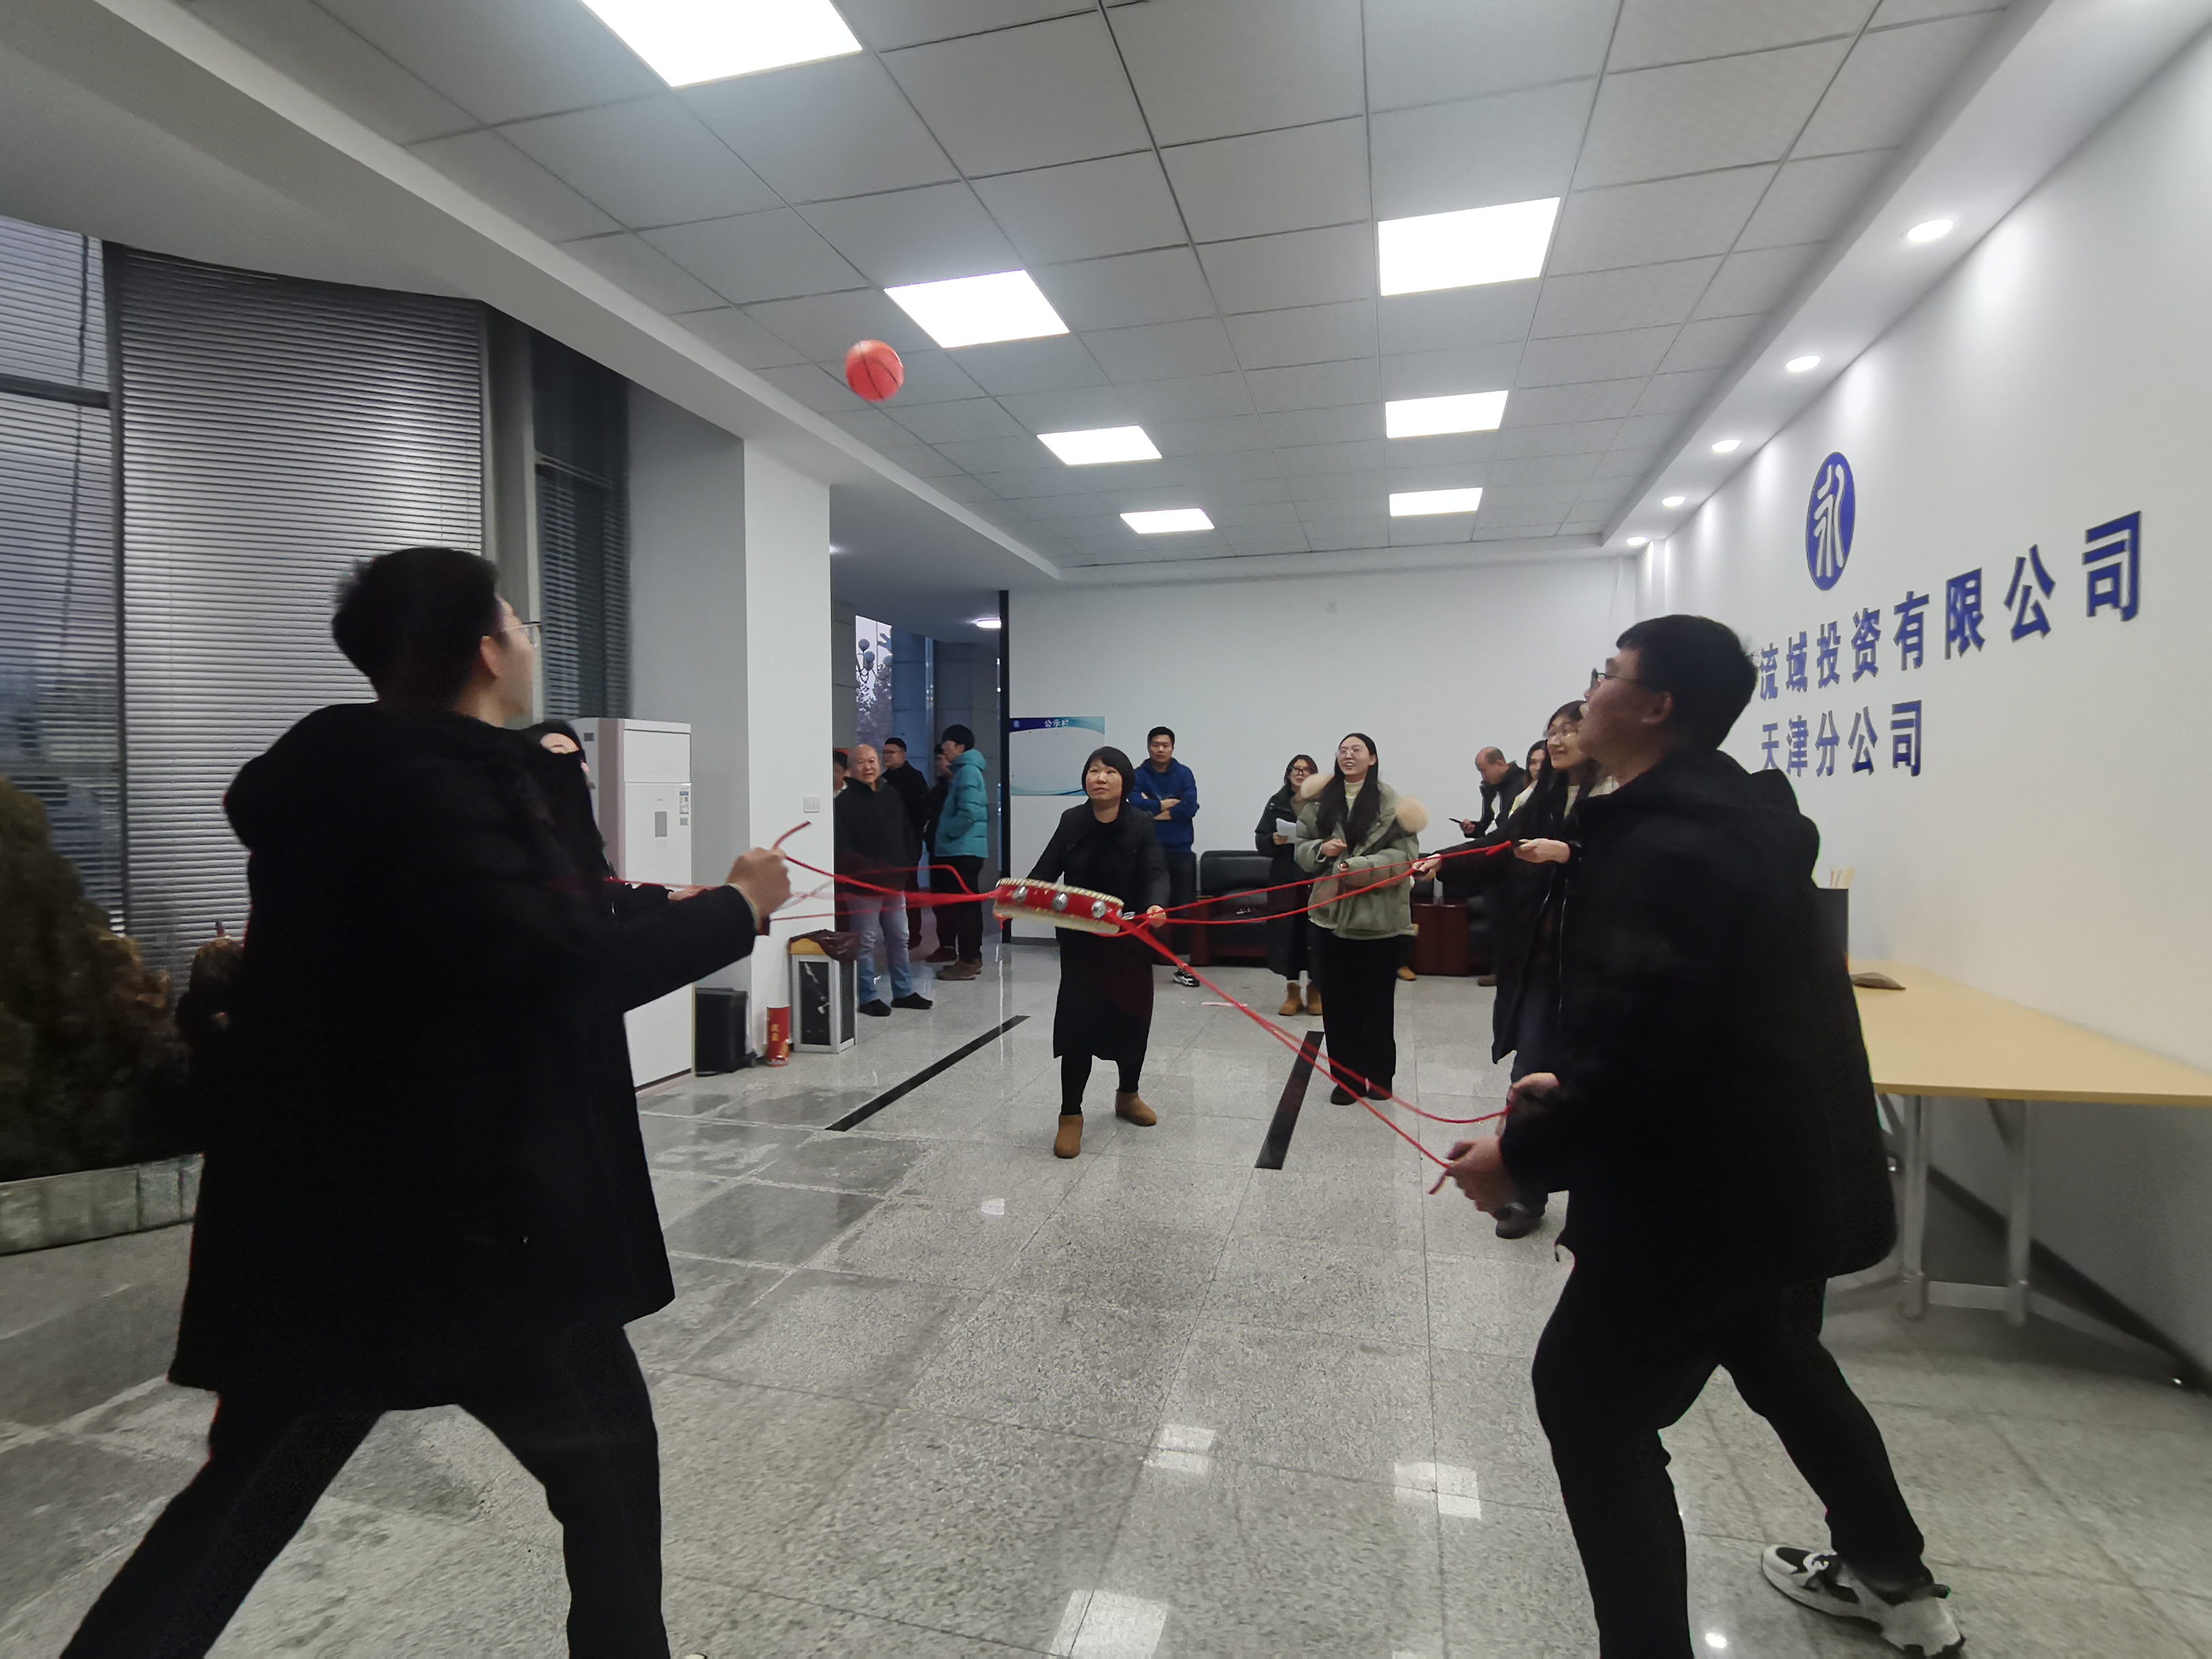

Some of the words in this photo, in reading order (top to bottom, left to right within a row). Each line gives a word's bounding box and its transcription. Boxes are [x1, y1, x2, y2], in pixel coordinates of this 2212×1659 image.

[1760, 510, 2142, 701] 流域投资有限公司
[1761, 699, 1922, 777] 天津分公司
